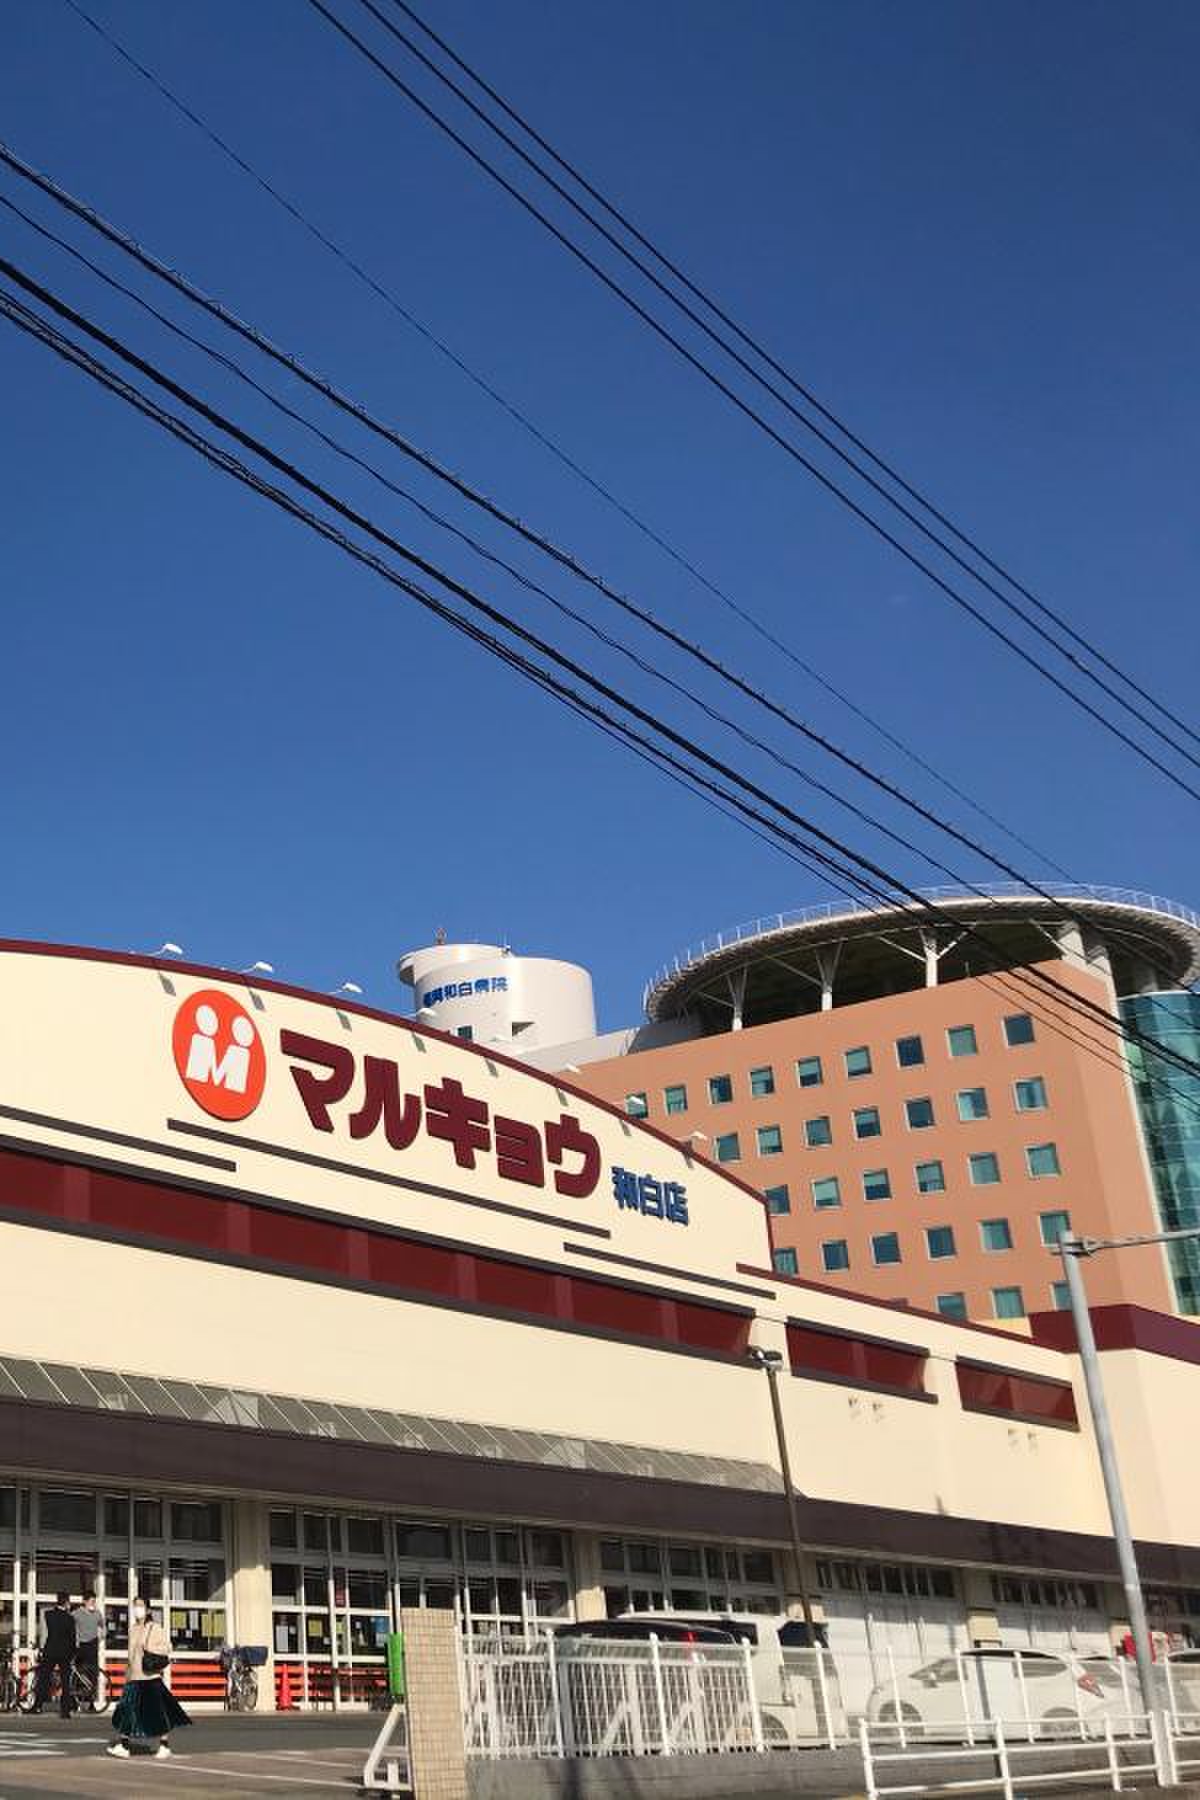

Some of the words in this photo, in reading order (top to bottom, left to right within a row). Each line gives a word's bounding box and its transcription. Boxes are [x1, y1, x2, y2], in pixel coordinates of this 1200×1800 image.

[279, 1028, 602, 1199] マルキョウ
[611, 1166, 689, 1227] 和白店
